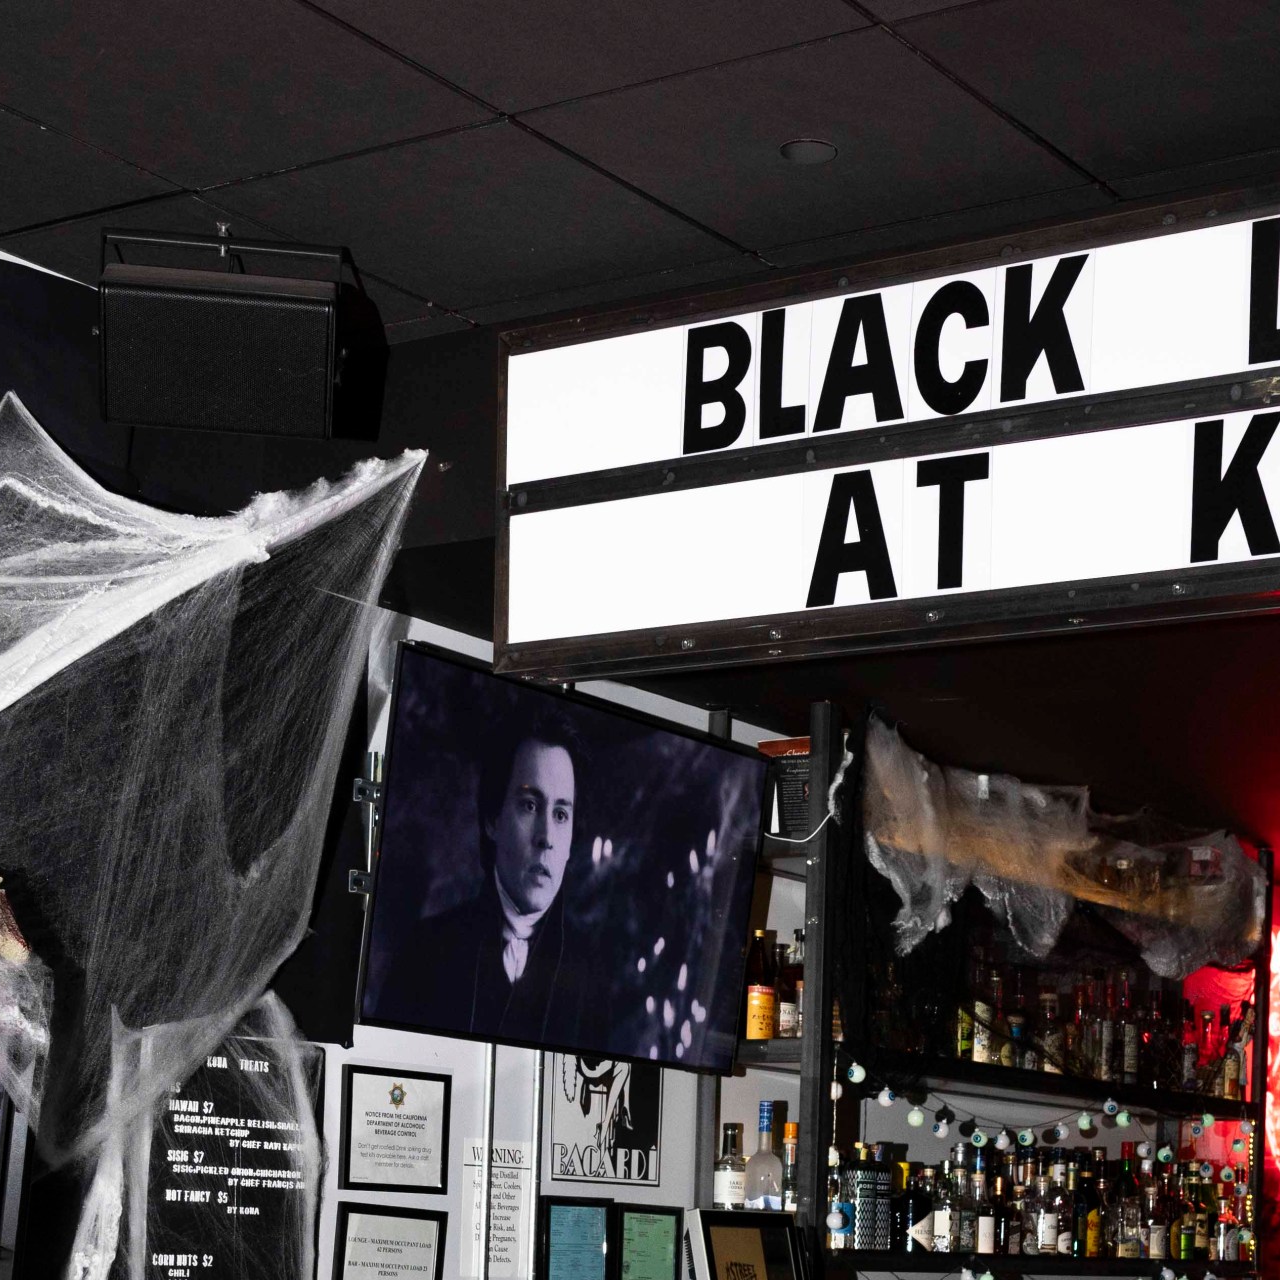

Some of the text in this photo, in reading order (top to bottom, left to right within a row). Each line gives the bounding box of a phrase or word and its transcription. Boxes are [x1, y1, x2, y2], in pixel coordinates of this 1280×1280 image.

[683, 254, 1089, 454] BLACK
[806, 452, 989, 608] AT
[207, 1056, 269, 1072] KONA TREATS
[203, 1101, 214, 1114] $7
[174, 1125, 250, 1138] SRIRACHA KETCHUP
[247, 1119, 300, 1131] RELISH,SHALL
[229, 1139, 240, 1148] BY
[241, 1140, 261, 1149] CHEF
[167, 1149, 204, 1163] SISIG $7
[472, 1147, 524, 1164] WRNING:
[228, 1178, 293, 1189] BY CHEF FRANCIS
[184, 1190, 211, 1203] FANCY
[218, 1191, 228, 1204] $5
[227, 1206, 260, 1215] BY KONA
[497, 1202, 520, 1211] Beverages
[492, 1212, 511, 1221] Increase
[494, 1244, 508, 1252] Cause
[152, 1253, 213, 1267] CORN NUTS $2
[168, 1268, 190, 1277] CHILI
[730, 1262, 755, 1280] STREET
